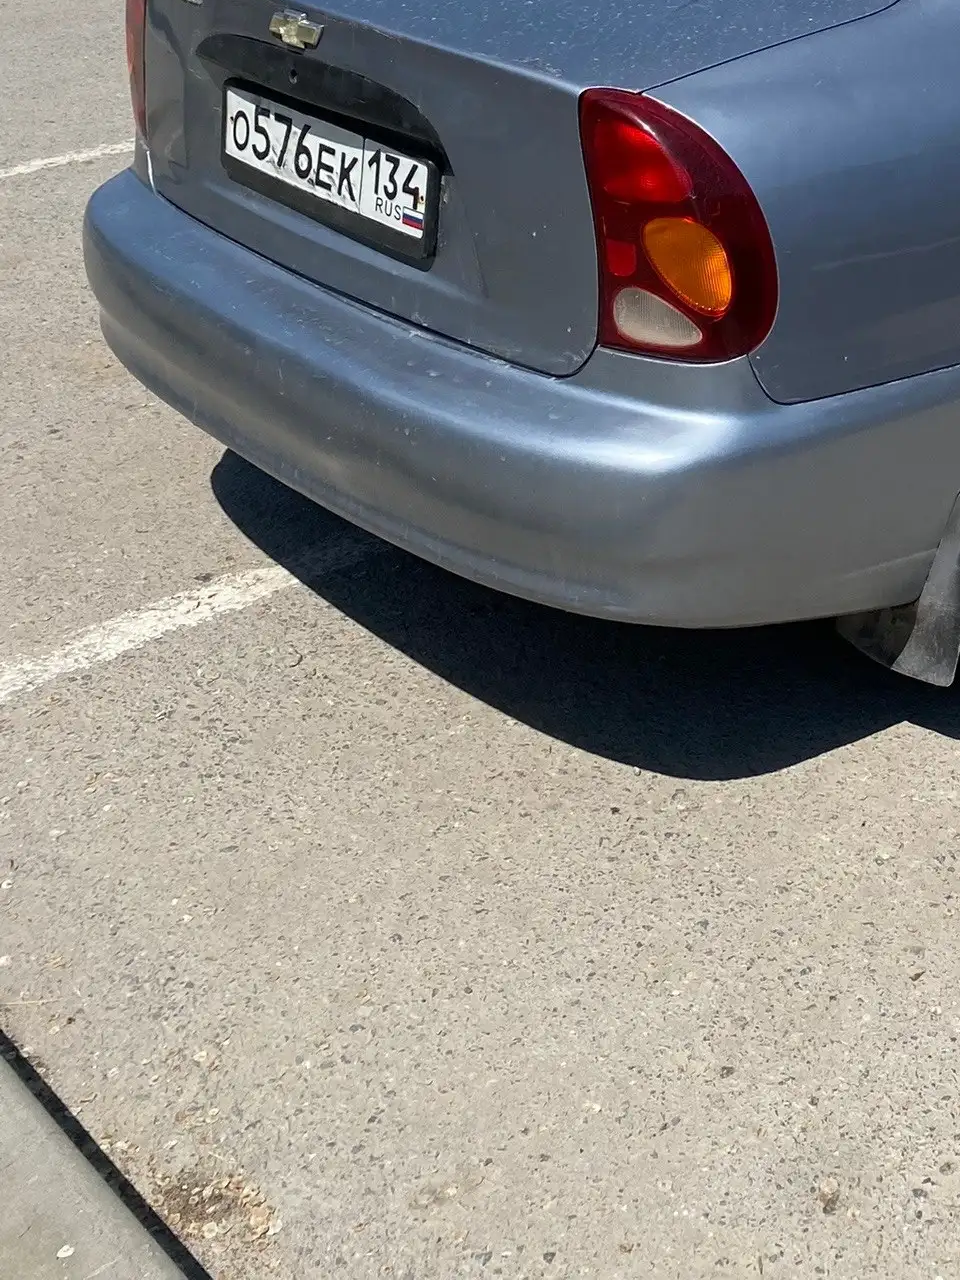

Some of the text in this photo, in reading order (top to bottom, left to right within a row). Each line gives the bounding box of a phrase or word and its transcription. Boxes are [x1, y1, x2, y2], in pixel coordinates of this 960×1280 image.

[232, 104, 420, 210] О576ЕК 134
[374, 196, 402, 221] RUS
